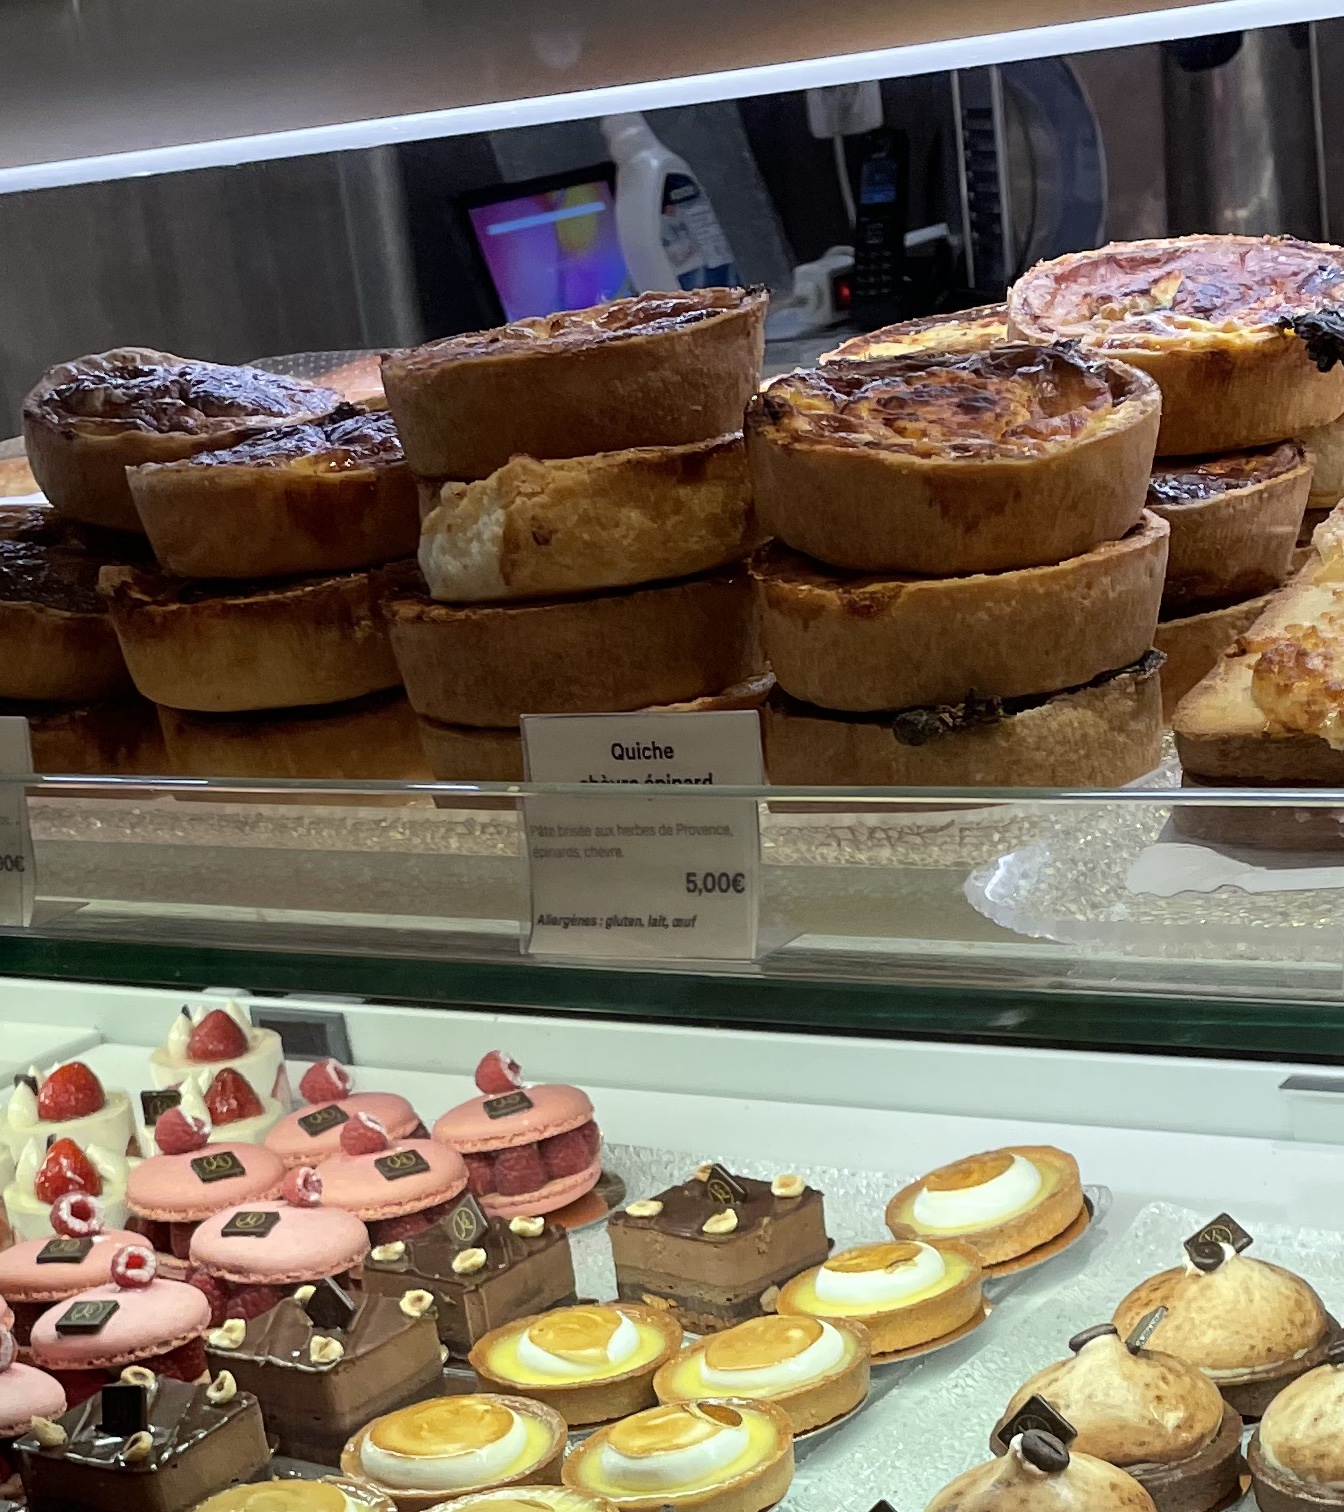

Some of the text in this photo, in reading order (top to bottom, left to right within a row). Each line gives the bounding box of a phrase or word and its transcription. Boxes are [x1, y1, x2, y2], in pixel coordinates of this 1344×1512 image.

[610, 740, 674, 761] Quiche
[658, 823, 673, 837] de
[685, 872, 745, 896] 5,00€
